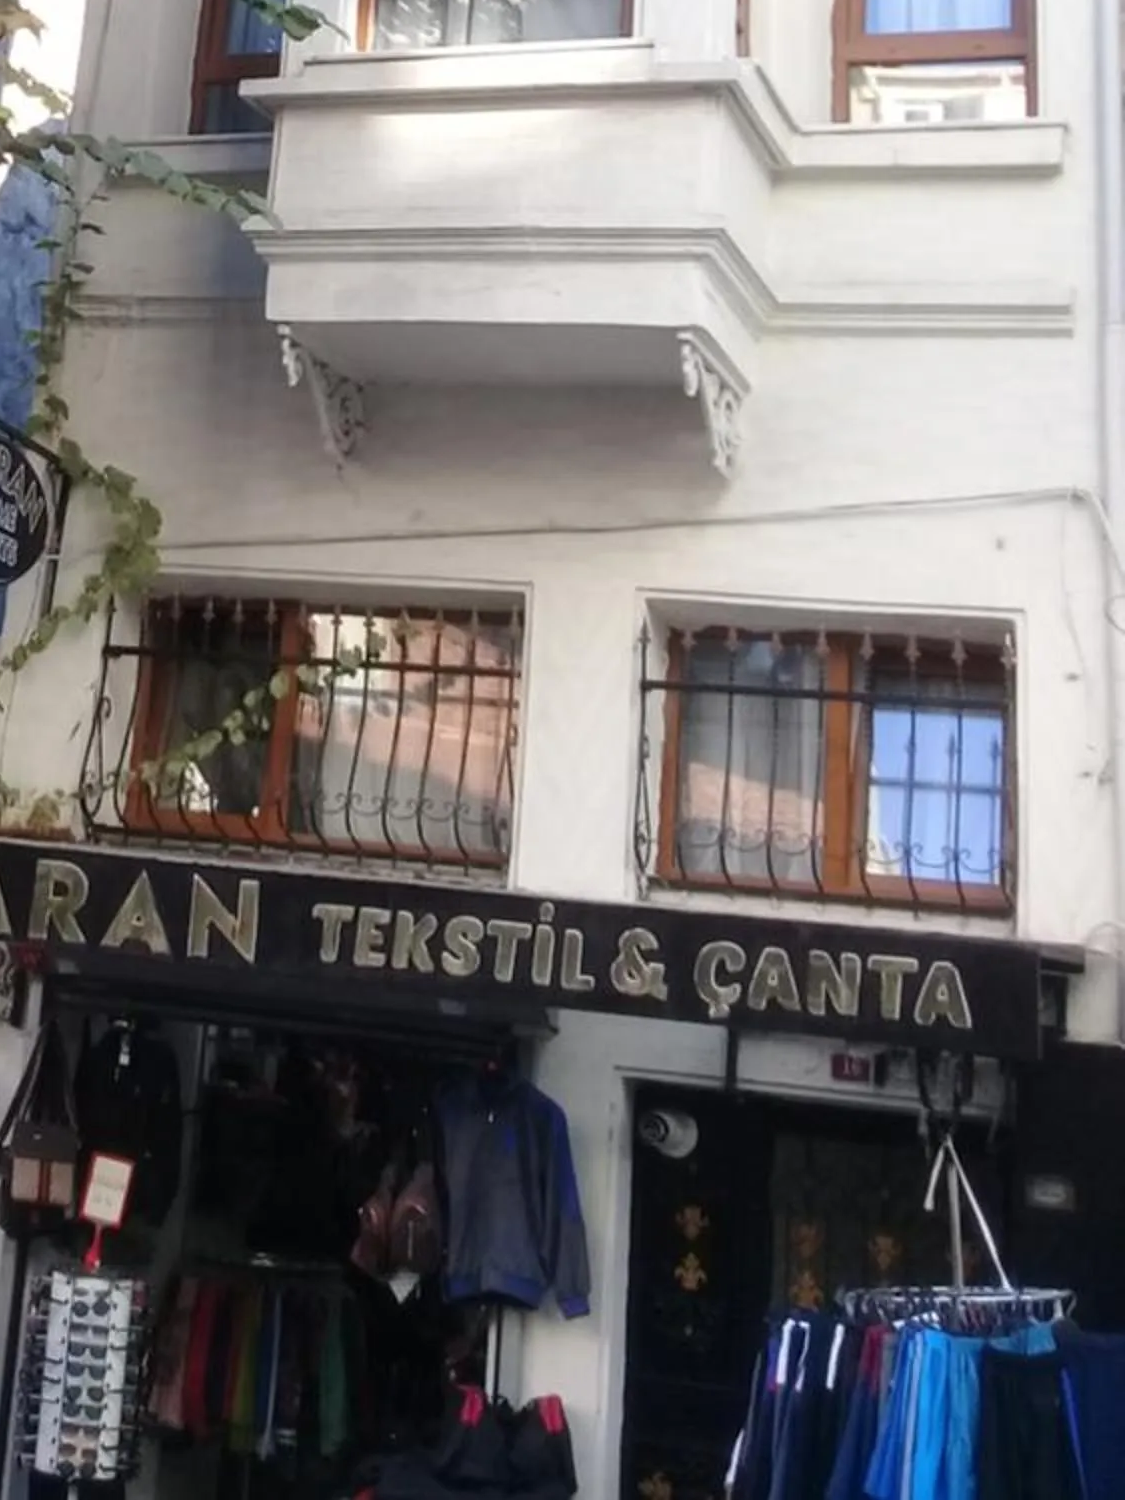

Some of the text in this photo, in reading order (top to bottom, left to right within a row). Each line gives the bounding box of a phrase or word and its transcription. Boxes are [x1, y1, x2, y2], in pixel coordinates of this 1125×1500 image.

[311, 901, 595, 991] TEKSTİL
[610, 927, 668, 1001] &
[693, 940, 973, 1029] ÇANTA
